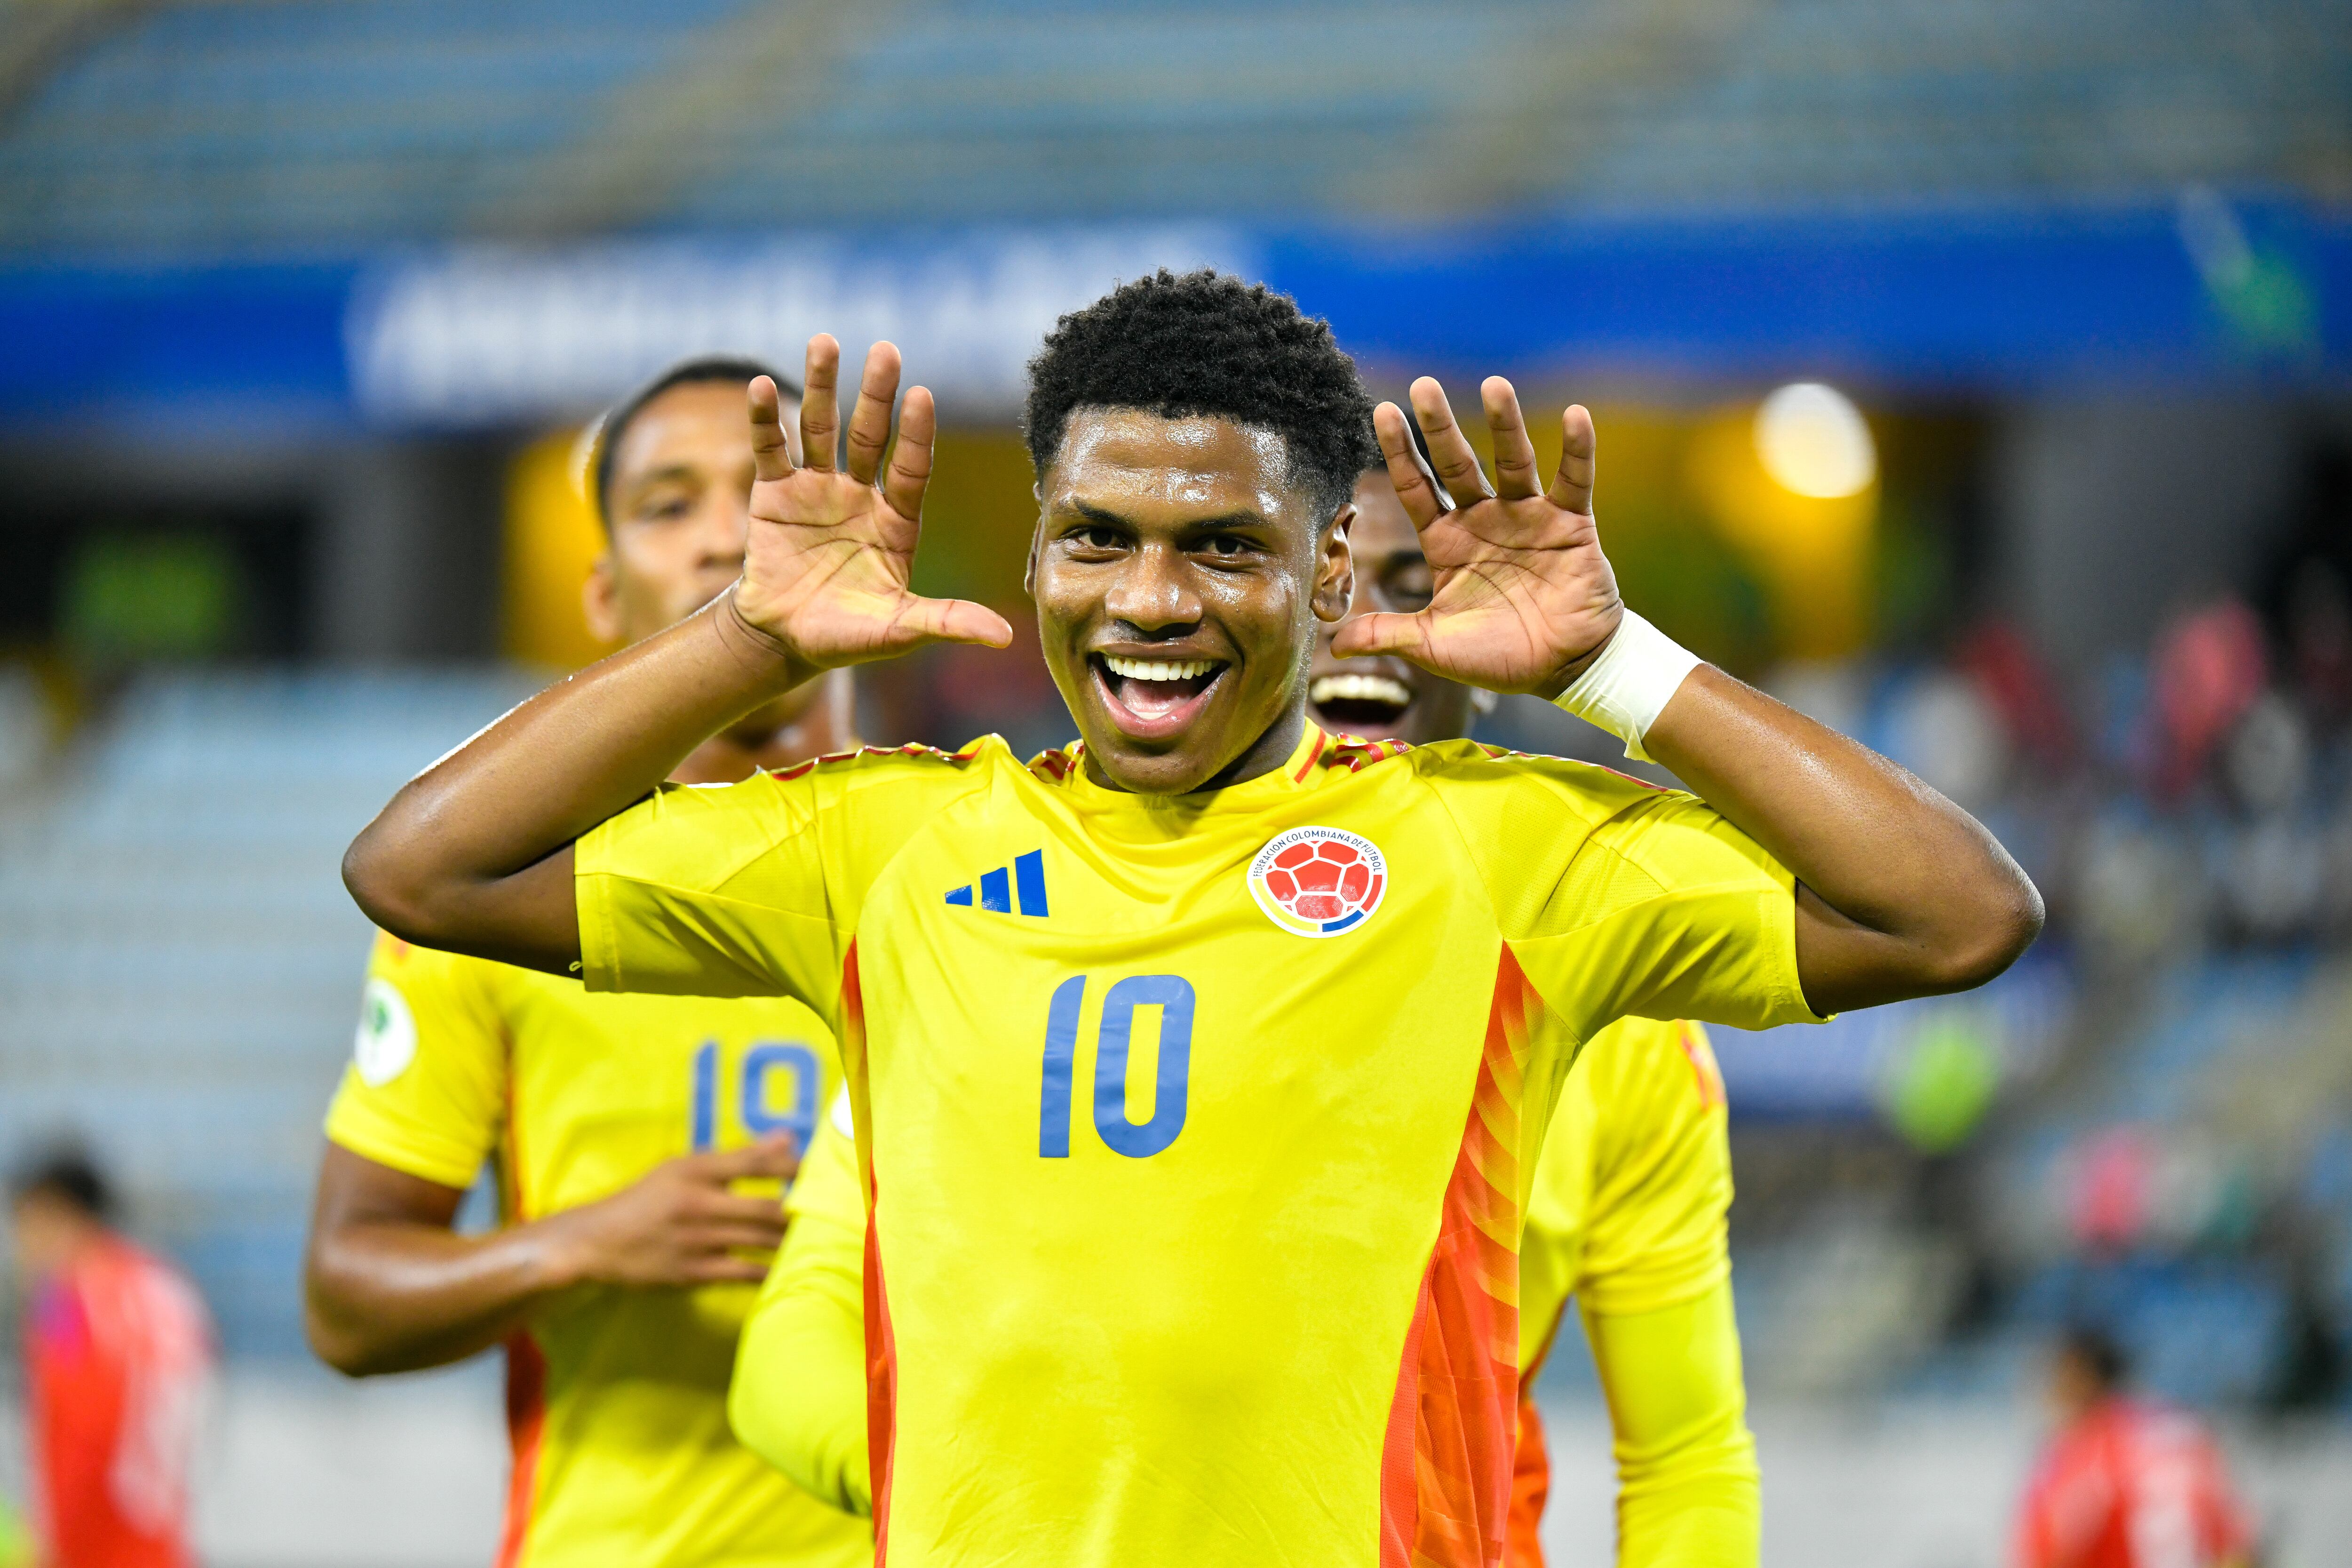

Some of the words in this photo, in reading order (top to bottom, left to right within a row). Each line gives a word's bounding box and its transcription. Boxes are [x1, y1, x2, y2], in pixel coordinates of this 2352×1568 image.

[1253, 839, 1287, 876] FEDERACIÓN
[1287, 830, 1350, 843] COLOMBIANA
[1351, 838, 1363, 847] DE
[693, 1041, 818, 1164] 19
[1039, 975, 1195, 1158] 10
